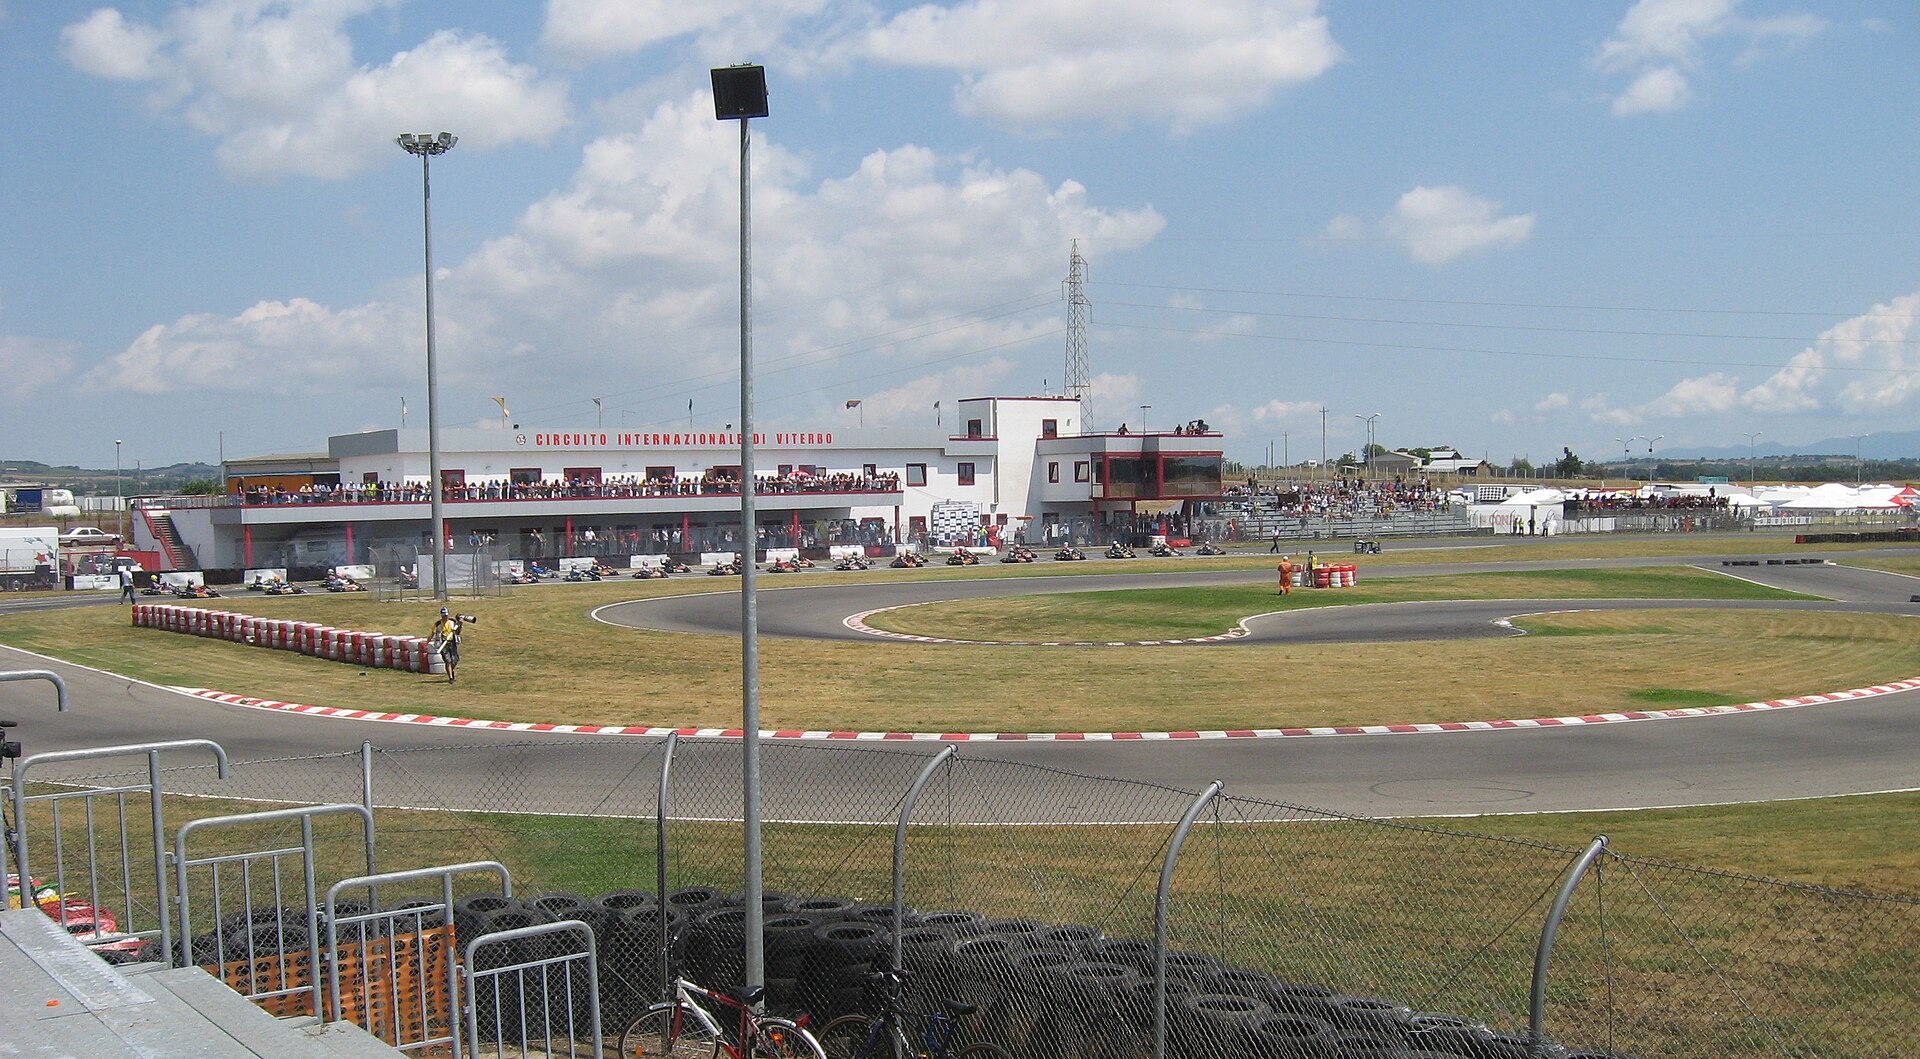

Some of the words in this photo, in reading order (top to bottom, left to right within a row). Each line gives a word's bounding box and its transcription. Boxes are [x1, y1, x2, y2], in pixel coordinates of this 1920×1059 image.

[536, 434, 607, 446] CIRCUITO
[617, 433, 743, 446] INTERNAZIONALE
[753, 433, 767, 445] DI
[776, 433, 833, 444] VITERBO
